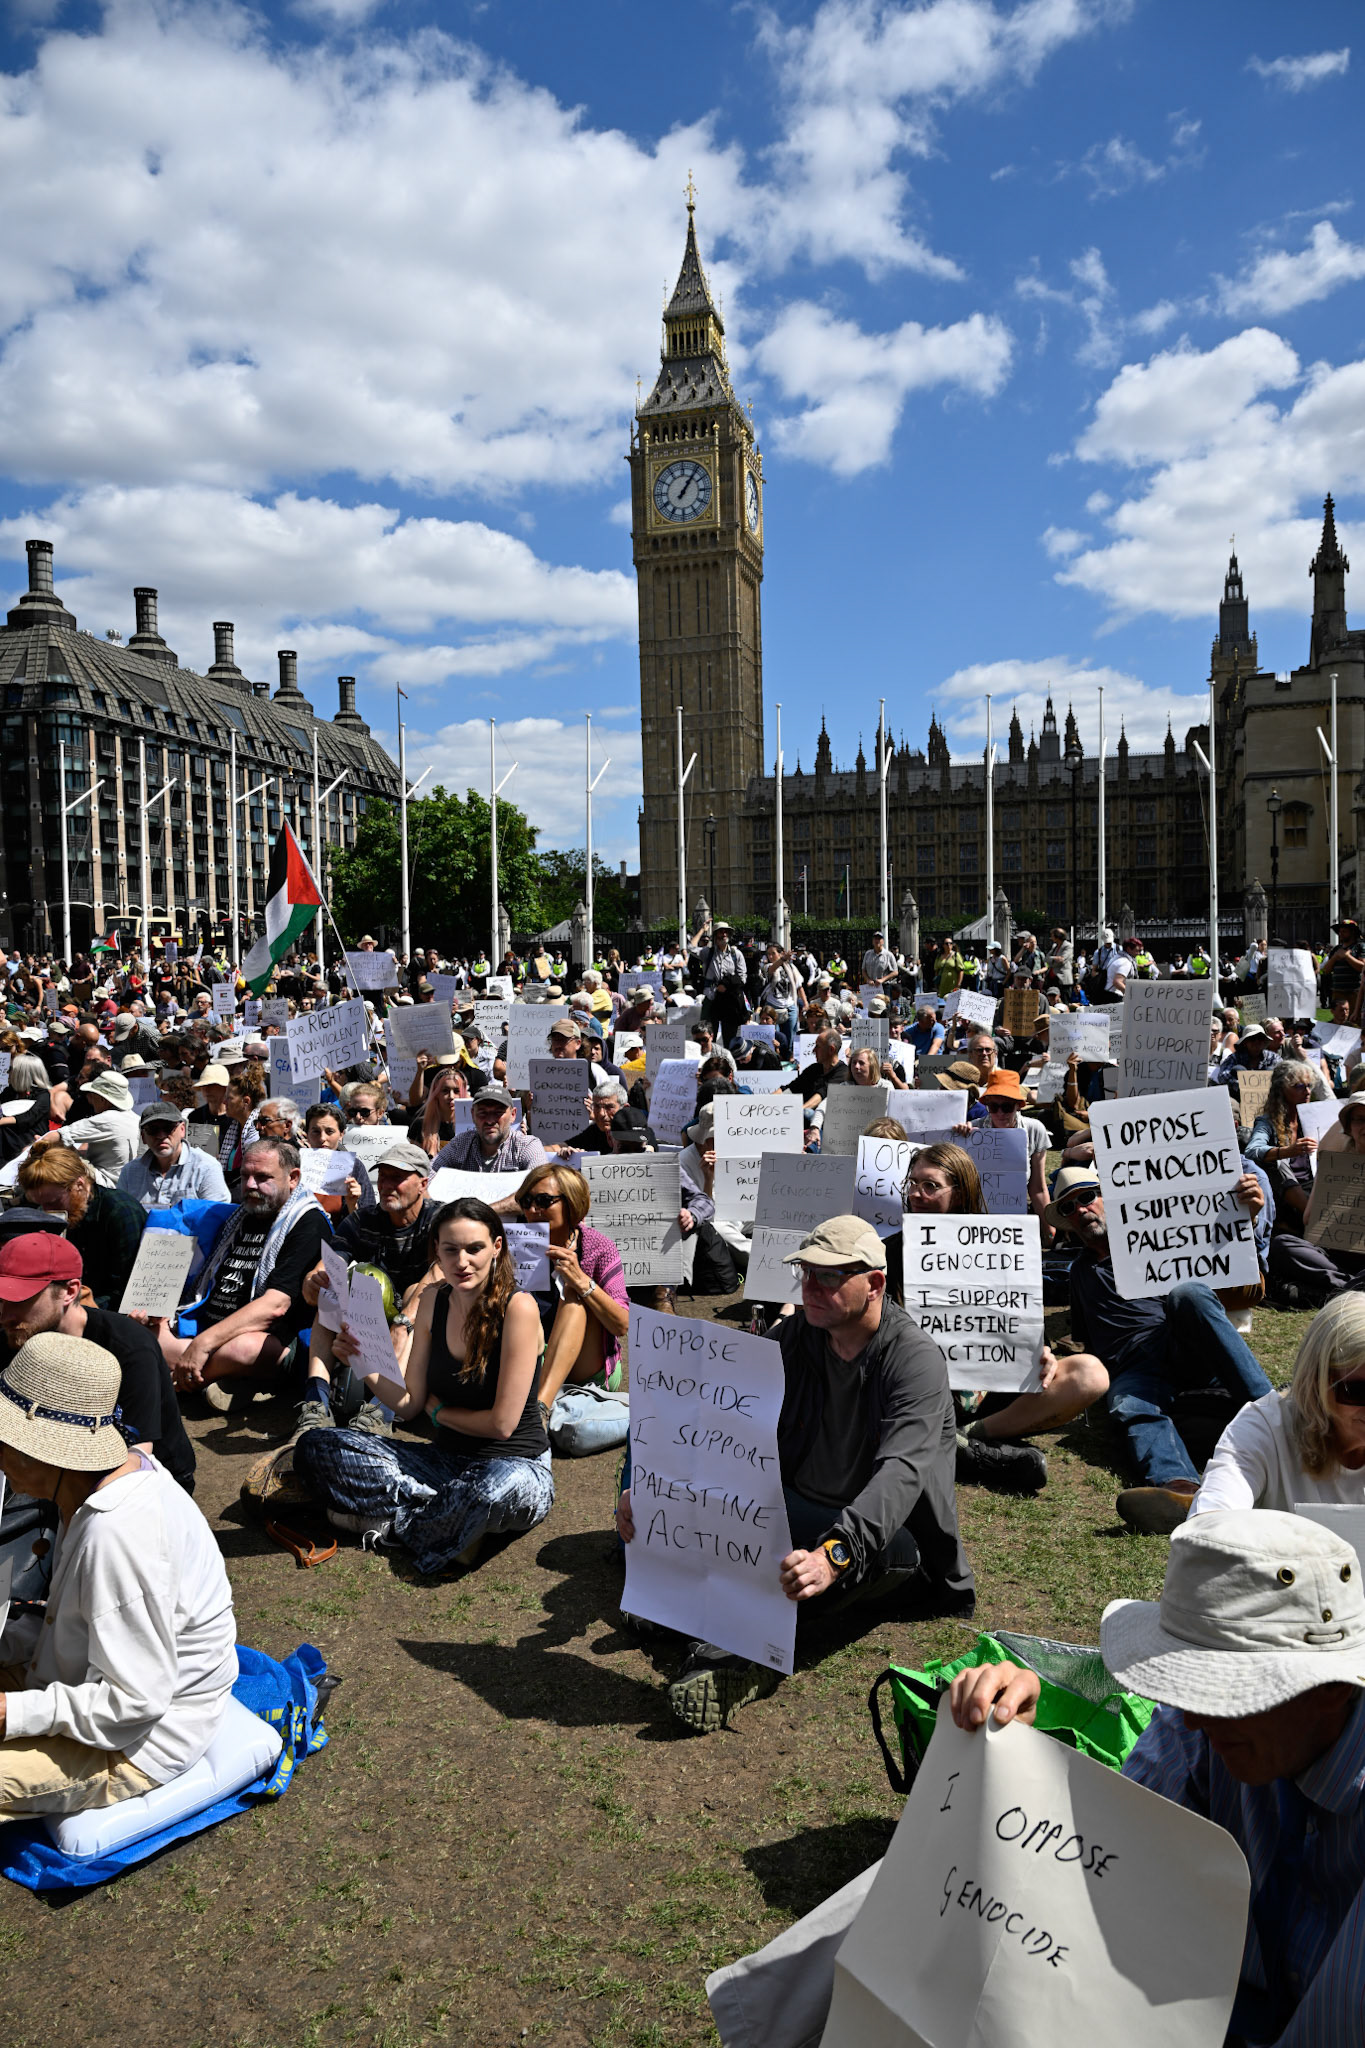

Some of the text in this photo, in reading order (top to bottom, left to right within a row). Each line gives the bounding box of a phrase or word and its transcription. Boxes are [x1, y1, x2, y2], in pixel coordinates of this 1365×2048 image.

[1129, 986, 1207, 1001] I OPPOSE
[476, 1003, 509, 1012] I oppose
[522, 1010, 557, 1020] OPPOSE
[1133, 1005, 1211, 1026] GENOCIDE
[289, 1005, 362, 1042] OUR RIGHT TO
[510, 1025, 551, 1038] GENOCI
[297, 1021, 360, 1057] NON-VIOLENT
[660, 1031, 680, 1041] OPPOSE
[748, 1031, 773, 1041] OPPOSE
[651, 1045, 681, 1054] GENOCIDE
[1125, 1034, 1129, 1049] I
[1136, 1034, 1207, 1055] SUPPORT
[303, 1041, 359, 1076] PROTEST
[545, 1066, 583, 1078] OPPOSE
[668, 1066, 696, 1080] OPPOSE
[919, 1065, 946, 1075] OPPOS
[1124, 1058, 1208, 1082] PALESTINE
[736, 1076, 760, 1085] PPOSE
[532, 1106, 582, 1117] PALESTINE
[661, 1101, 692, 1113] SUPPORT
[726, 1101, 794, 1120] I OPPOSE
[537, 1119, 580, 1132] ACTION
[657, 1113, 691, 1124] PALESTI
[660, 1124, 682, 1135] ACTIO
[727, 1126, 791, 1137] GENOCIDE
[1103, 1110, 1209, 1149] I OPPOSE
[352, 1133, 393, 1146] OPPOSE
[828, 1137, 857, 1147] PALESTIN
[920, 1132, 927, 1145] I
[861, 1139, 866, 1171] I
[966, 1148, 1004, 1161] CIDE
[589, 1165, 654, 1180] I OPPOSE
[725, 1160, 730, 1173] I
[769, 1158, 780, 1173] I
[796, 1160, 845, 1175] OPPOSE
[1111, 1149, 1235, 1188] GENOCIDE
[590, 1188, 658, 1204] GENOCIDE
[771, 1183, 835, 1200] GENOCIDE
[987, 1191, 1023, 1207] ACTION
[1120, 1190, 1239, 1225] I SUPPORT
[587, 1212, 664, 1228] I SUPPORT
[760, 1209, 826, 1224] I SUPPORT
[1319, 1208, 1365, 1227] PALES
[762, 1231, 798, 1248] PALES
[920, 1226, 1025, 1246] I OPPOSE
[1127, 1219, 1252, 1255] PALESTINE
[1319, 1226, 1365, 1245] ACTI
[232, 1245, 263, 1257] TRIANG
[614, 1236, 659, 1252] ESTINE
[623, 1262, 651, 1276] TION
[921, 1253, 1025, 1272] GENOCIDE
[1145, 1254, 1230, 1284] ACTION
[918, 1289, 1034, 1309] I SUPPORT
[920, 1314, 1020, 1334] PALESTINE
[635, 1316, 740, 1364] I OPPOSE
[635, 1363, 761, 1419] GENOCIDE
[633, 1416, 776, 1473] I SUPPORT
[634, 1464, 779, 1530] PALESTINE
[646, 1508, 763, 1568] ACTION
[940, 1772, 1120, 1879] I OPPOSE
[940, 1866, 1070, 1969] GENOCIDE
